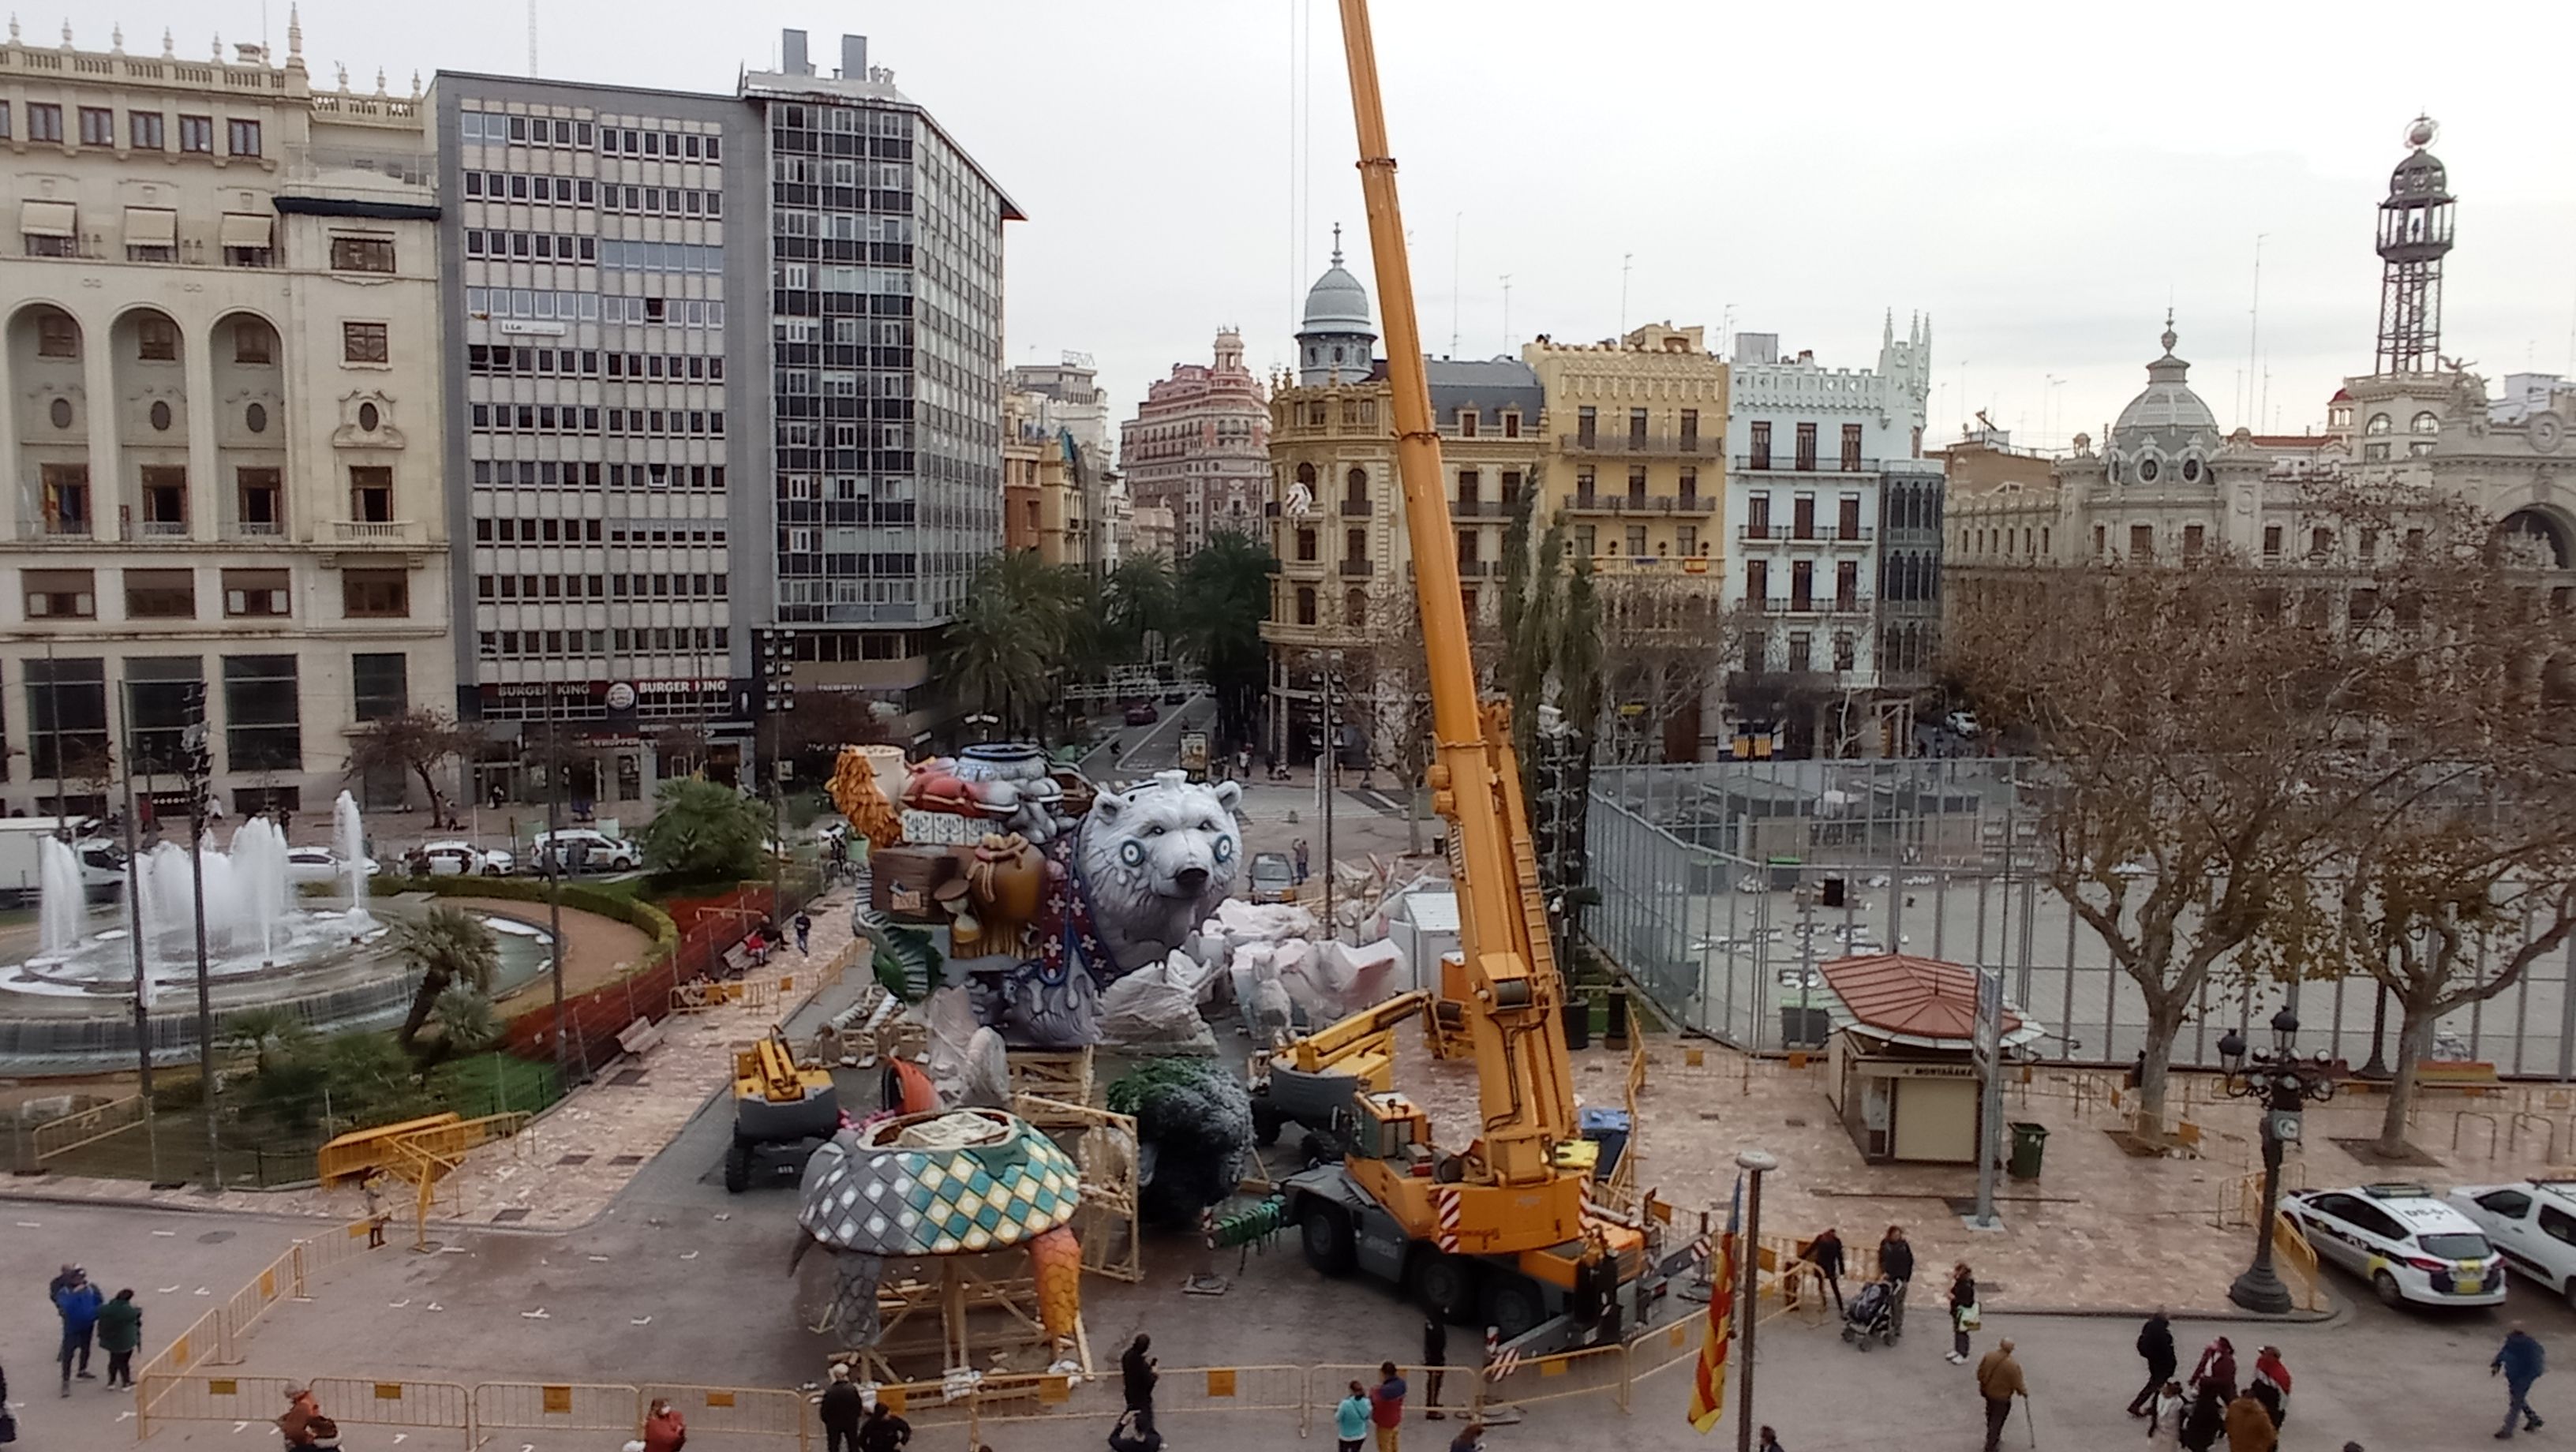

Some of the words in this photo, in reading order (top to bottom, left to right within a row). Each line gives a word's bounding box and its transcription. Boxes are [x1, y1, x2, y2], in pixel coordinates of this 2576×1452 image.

[556, 684, 590, 694] KING
[638, 682, 690, 694] BURGER
[695, 680, 727, 692] KING
